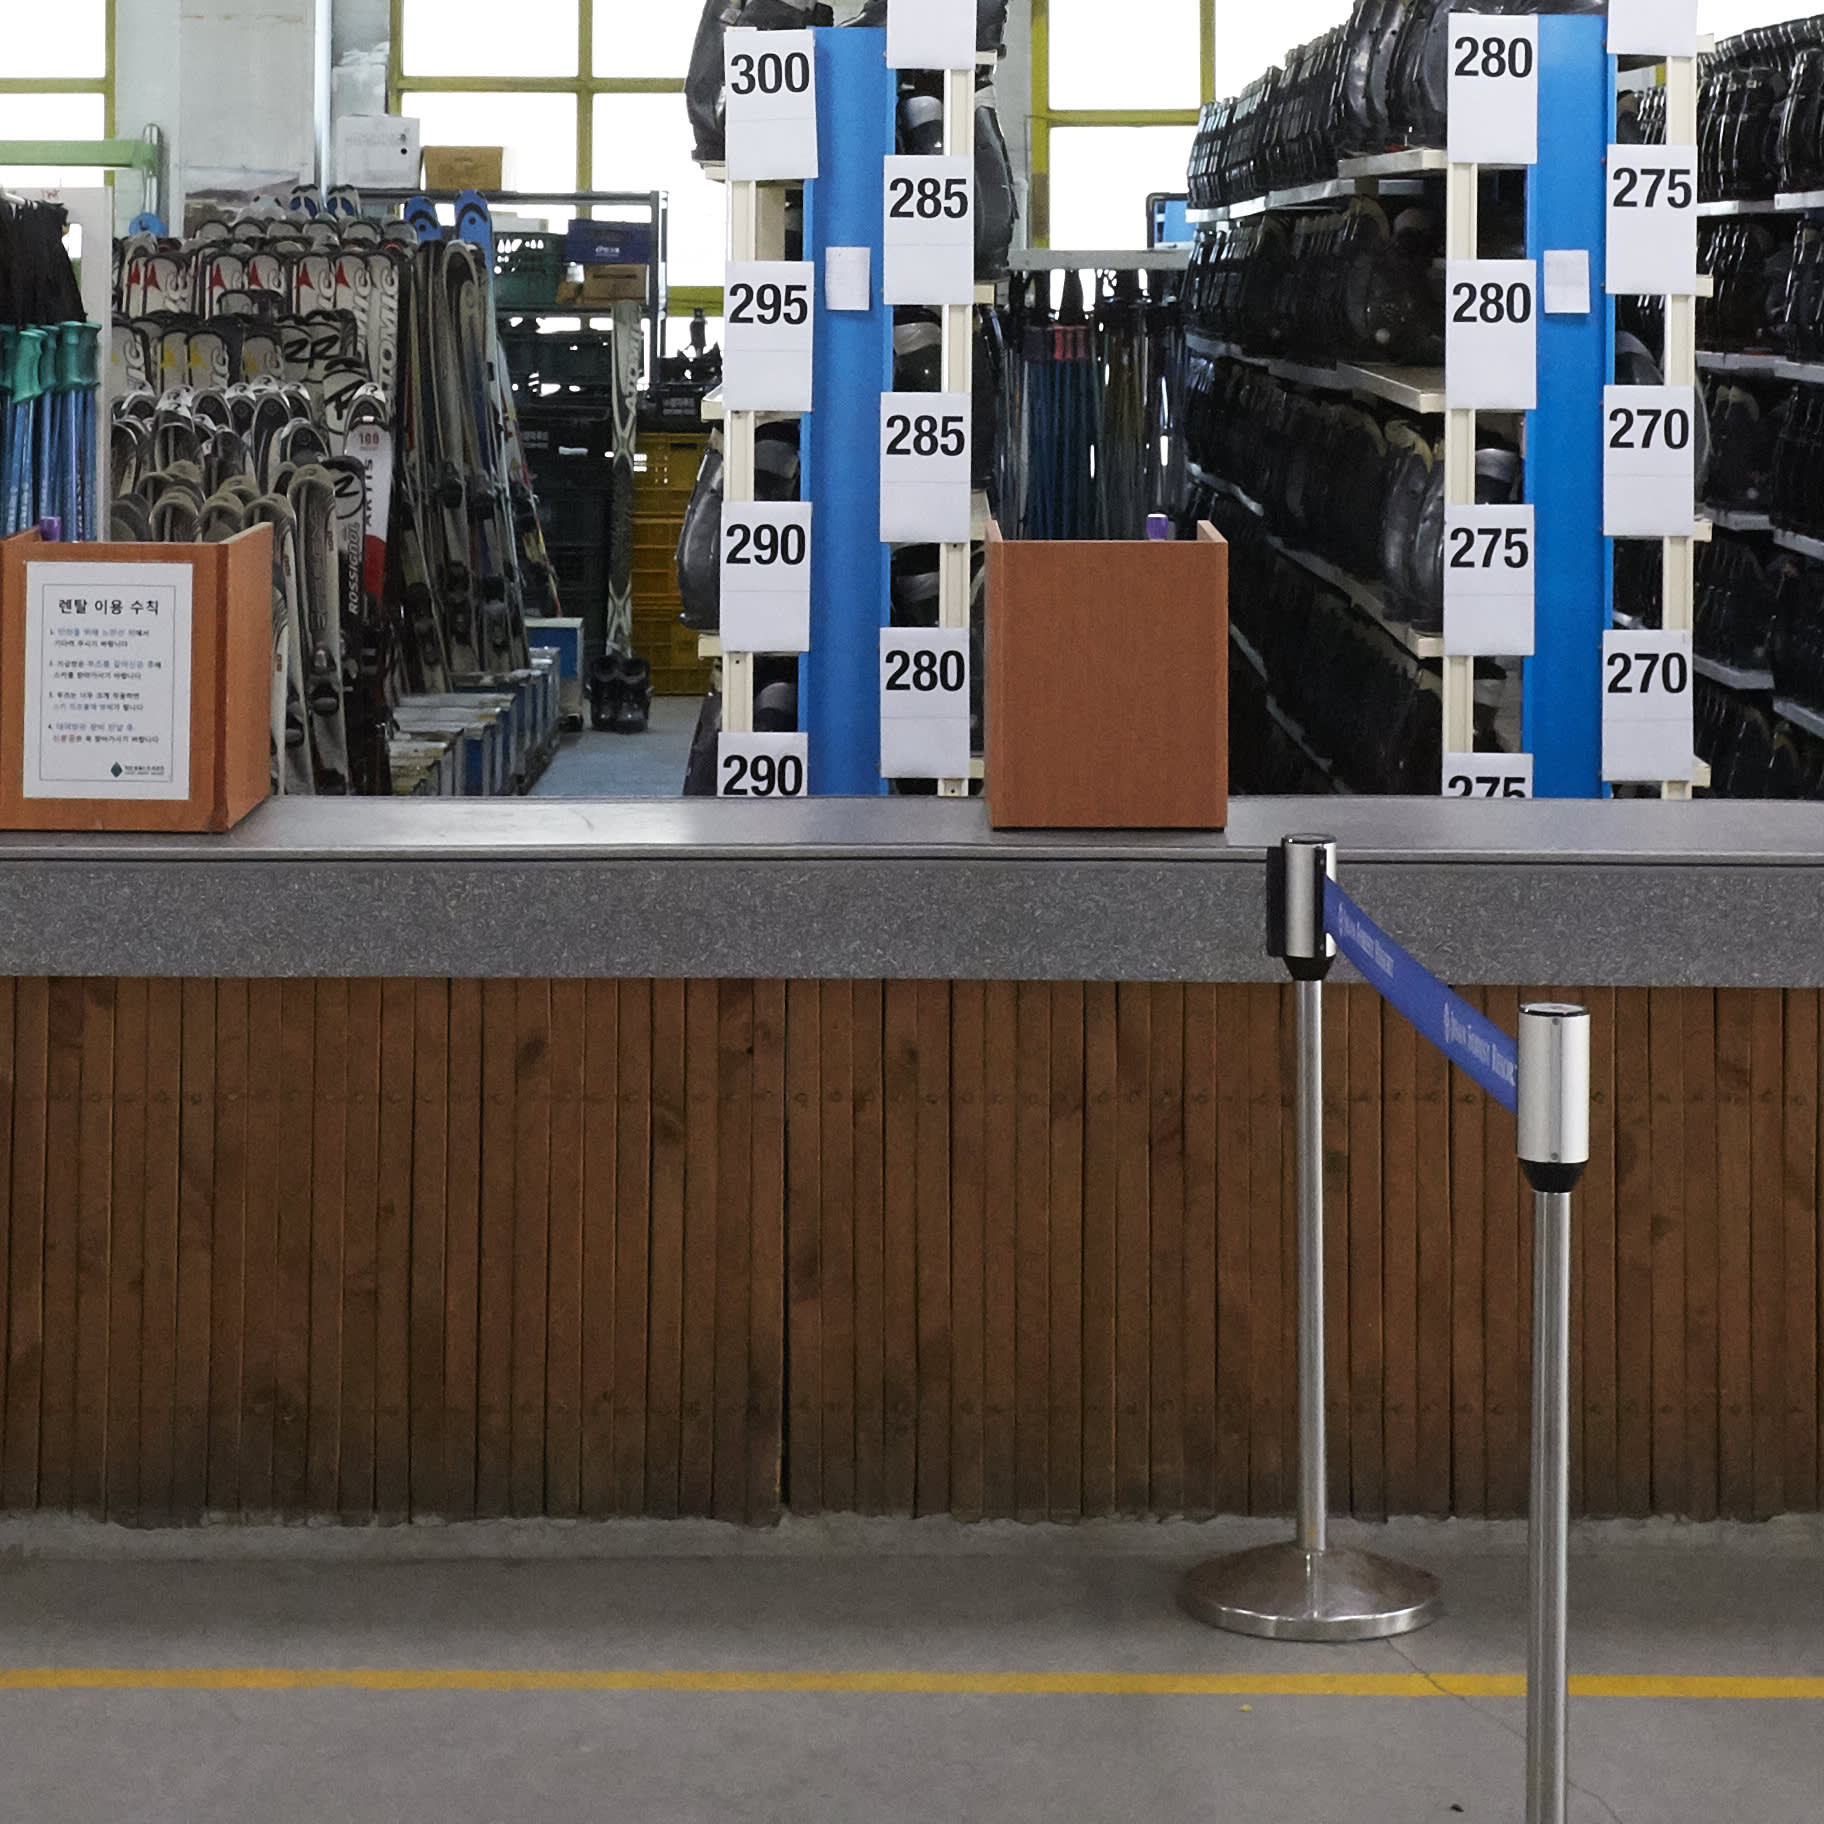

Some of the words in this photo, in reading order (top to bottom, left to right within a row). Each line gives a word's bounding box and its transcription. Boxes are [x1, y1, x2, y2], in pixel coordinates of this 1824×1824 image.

[731, 53, 809, 94] 300
[1455, 37, 1532, 77] 280
[890, 178, 968, 218] 285
[1613, 168, 1691, 208] 275
[729, 284, 808, 324] 295
[1452, 283, 1531, 323] 280
[886, 415, 965, 456] 285
[1609, 408, 1689, 449] 270
[726, 524, 805, 565] 290
[1450, 528, 1528, 568] 275
[59, 599, 88, 615] 렌탈
[94, 599, 123, 615] 이용
[130, 599, 159, 615] 수칙
[885, 650, 965, 691] 280
[1607, 653, 1687, 693] 270
[723, 755, 802, 796] 290
